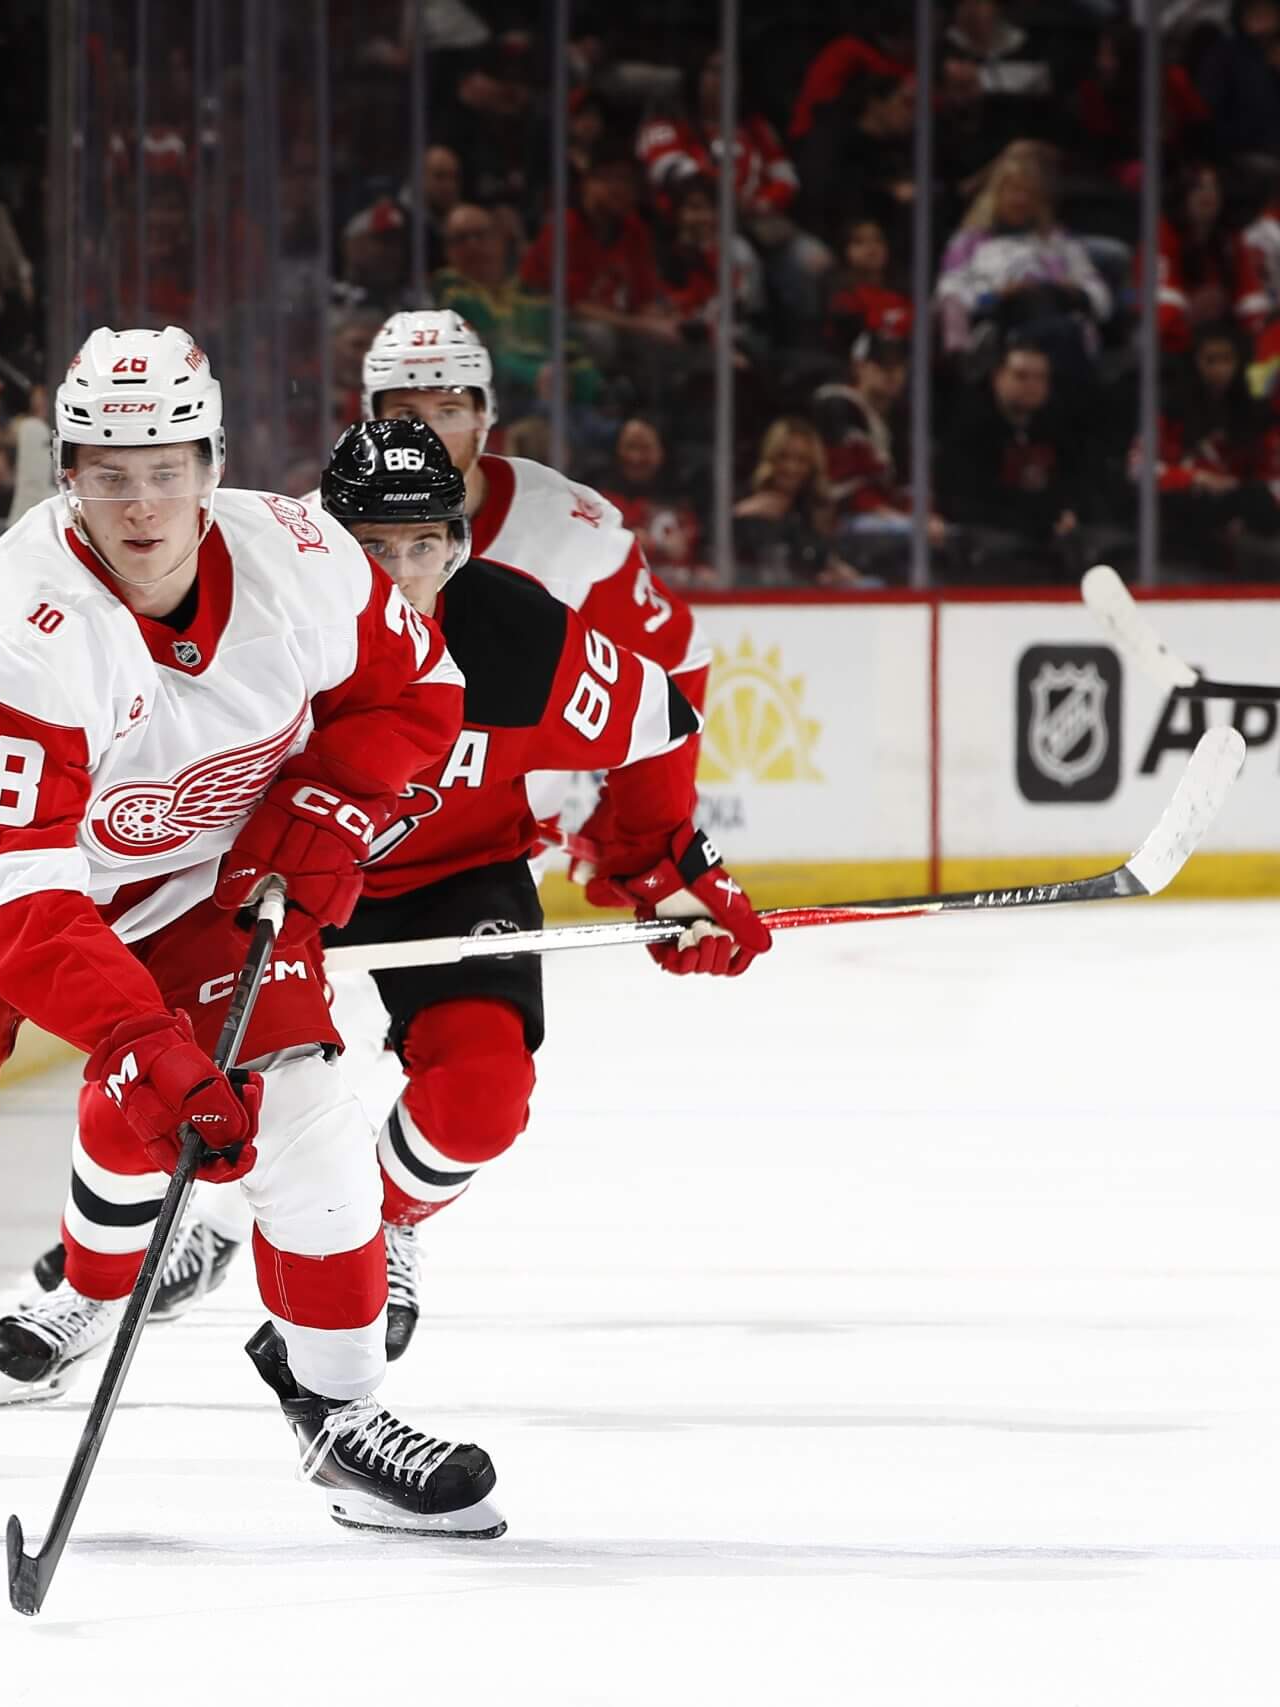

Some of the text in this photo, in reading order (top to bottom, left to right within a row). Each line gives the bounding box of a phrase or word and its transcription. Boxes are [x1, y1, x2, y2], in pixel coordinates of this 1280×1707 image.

[410, 330, 439, 346] 37
[103, 403, 156, 413] CCM
[384, 448, 424, 471] 86
[383, 493, 430, 501] BAUER
[27, 603, 65, 634] 10
[563, 629, 618, 741] 86
[438, 729, 489, 788] A
[104, 1051, 139, 1108] M
